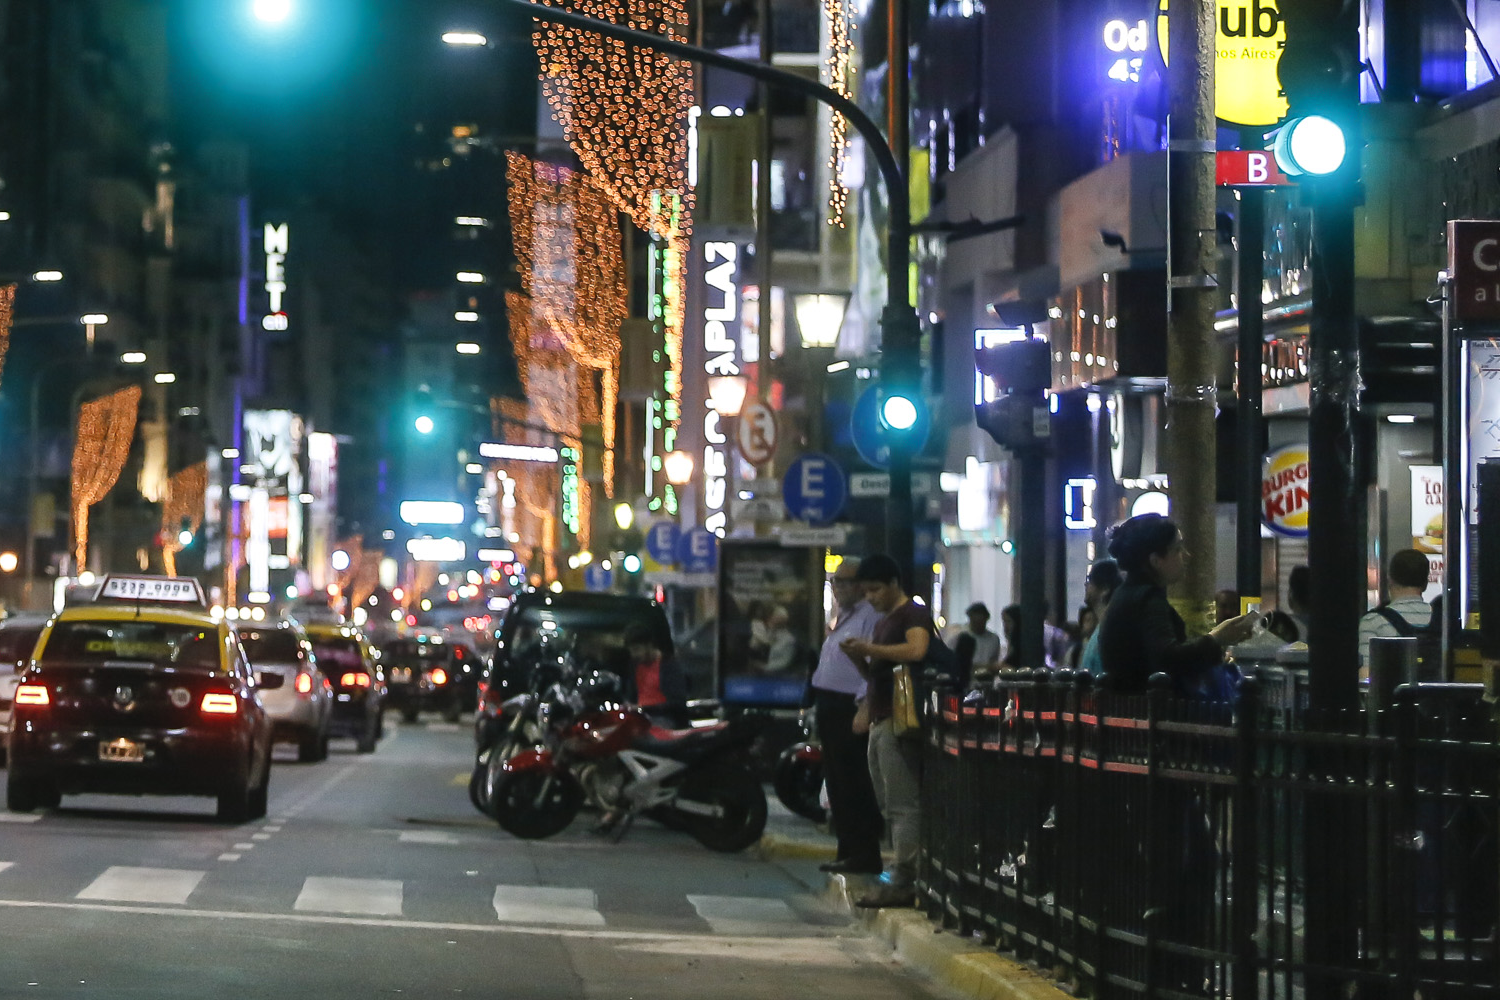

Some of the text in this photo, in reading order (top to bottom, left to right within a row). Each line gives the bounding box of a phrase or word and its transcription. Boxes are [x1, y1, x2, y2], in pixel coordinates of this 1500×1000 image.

[1241, 49, 1276, 59] Aires
[1248, 153, 1268, 183] B
[801, 459, 825, 497] E
[1262, 462, 1309, 499] BURG
